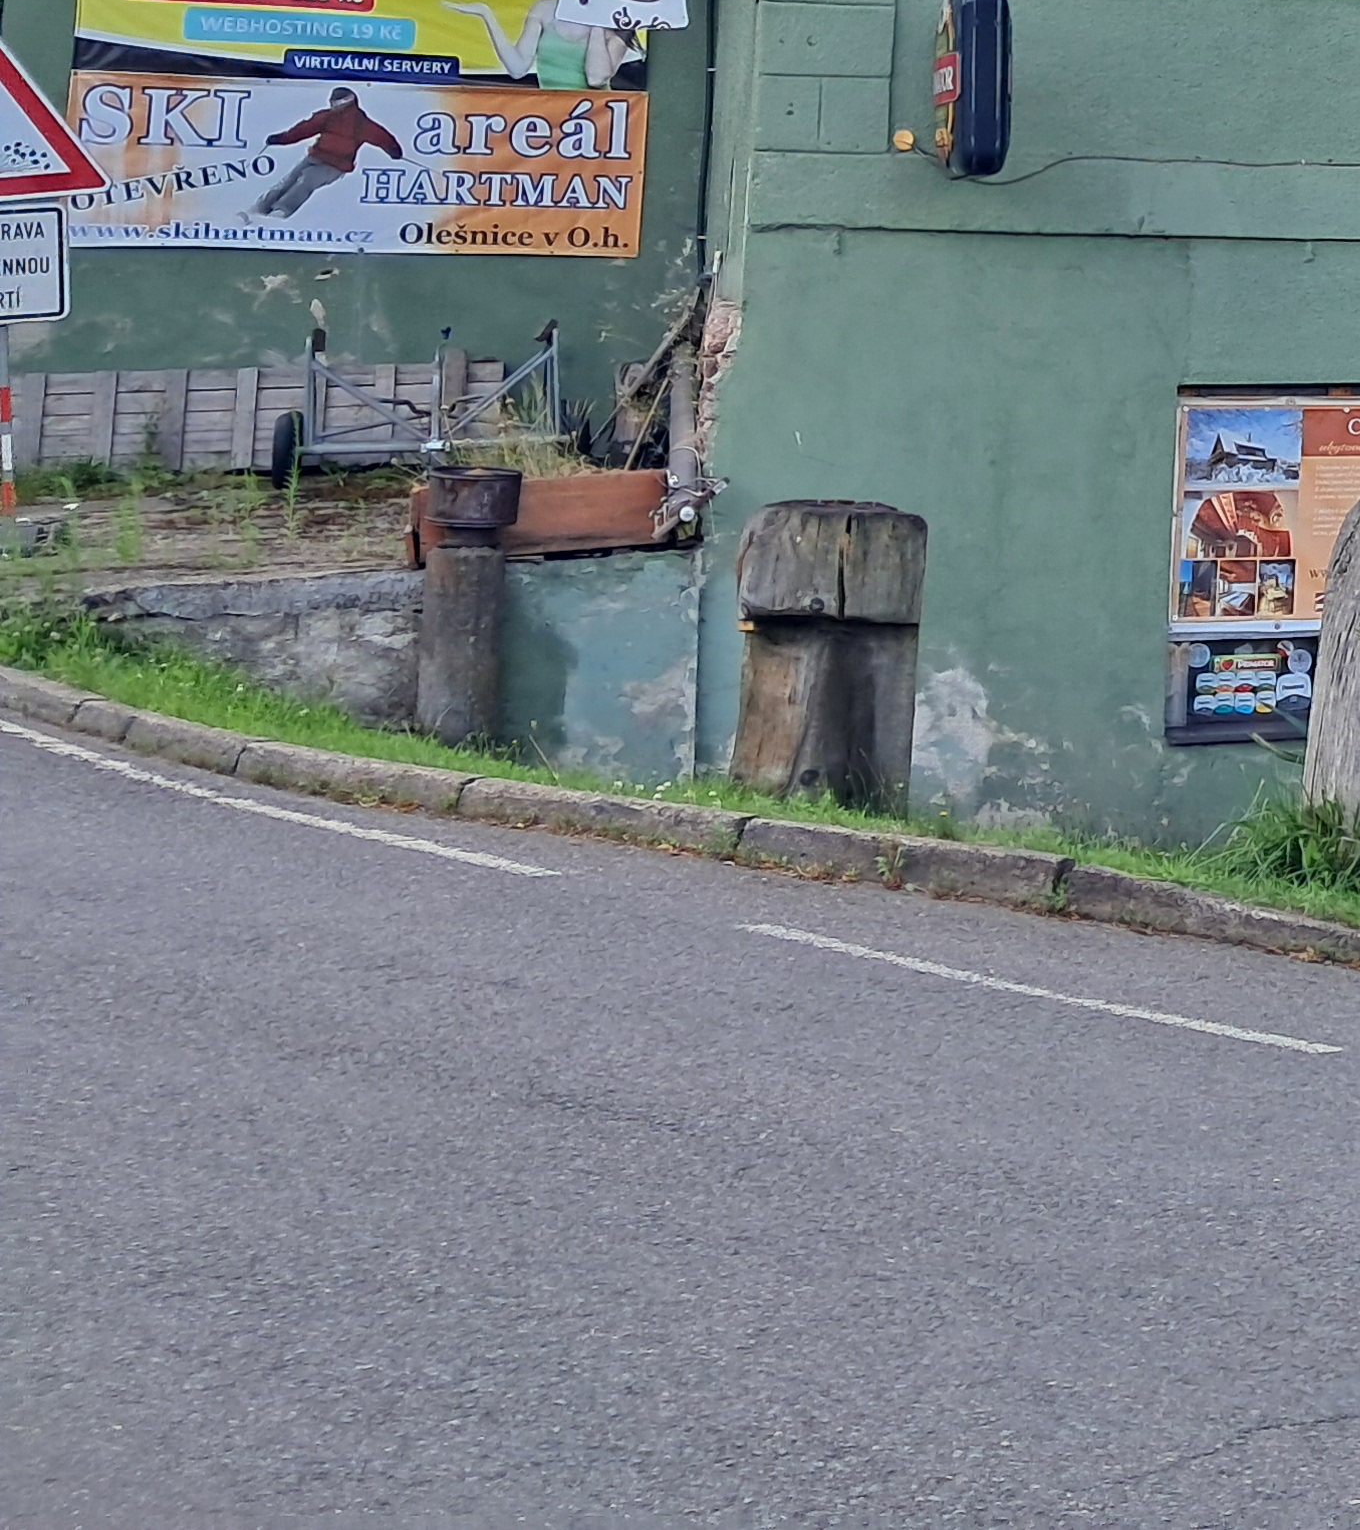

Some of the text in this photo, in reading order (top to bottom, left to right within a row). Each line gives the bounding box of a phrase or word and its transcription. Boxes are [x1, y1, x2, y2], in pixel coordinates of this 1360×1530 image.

[199, 15, 402, 41] WEBHOSTING 19 Kč
[293, 50, 452, 75] VIRTUÁLNÍ SERVERY
[78, 82, 632, 160] SKI areál
[70, 154, 276, 211] OTEVŘENO
[359, 168, 632, 210] HARTMAN
[68, 222, 630, 249] www.skihartman.cz Olešnice v O.h.
[0, 256, 49, 275] NNOU
